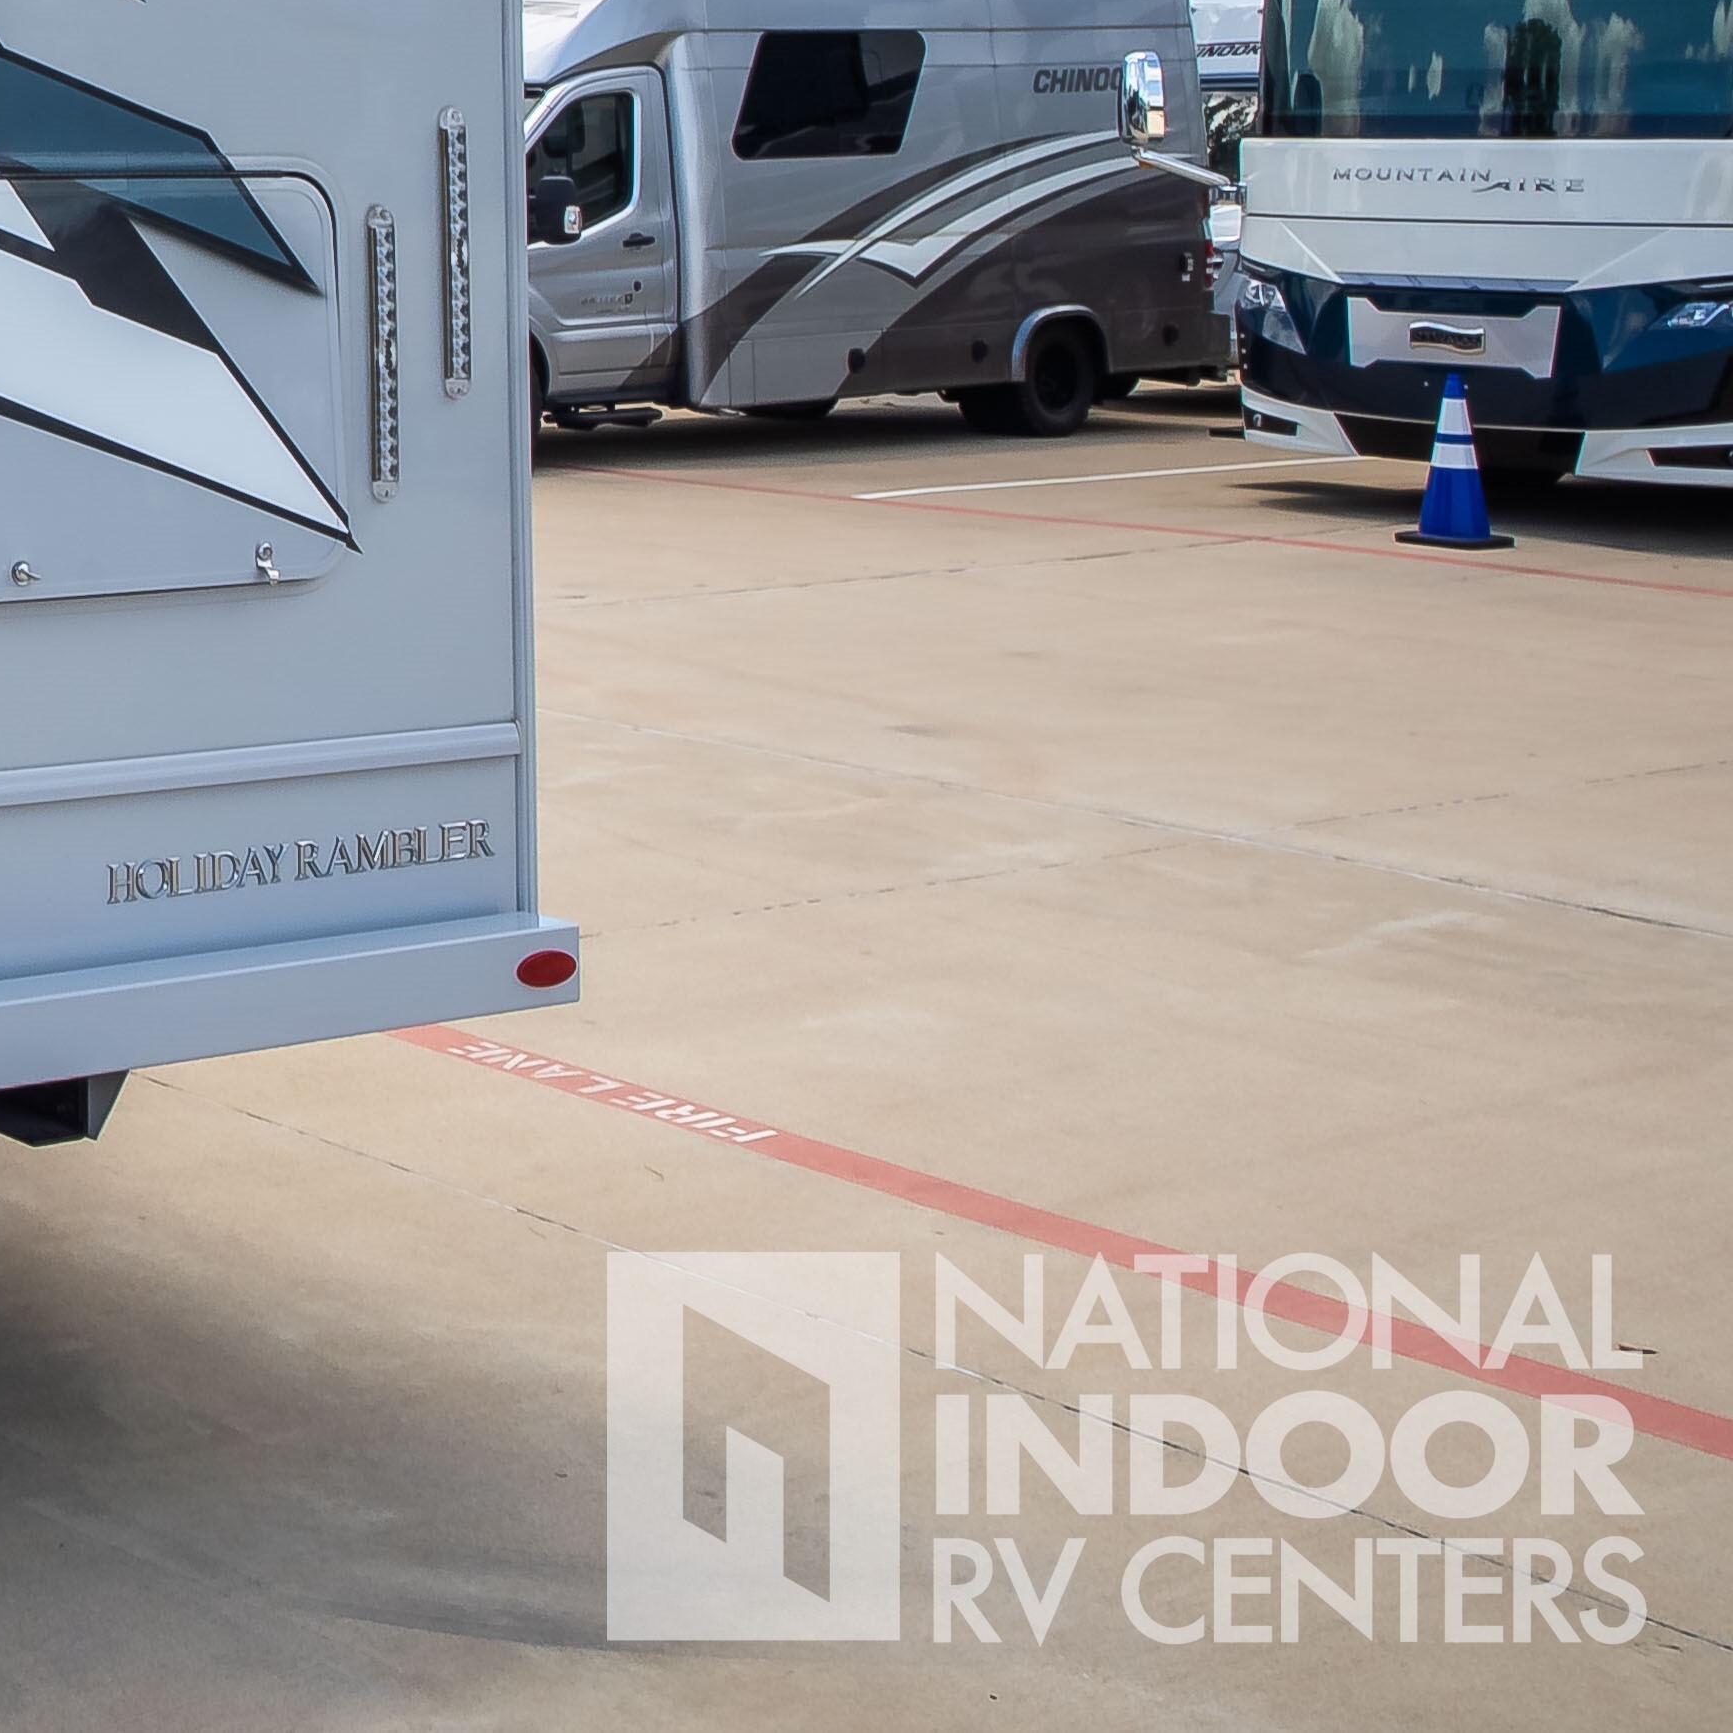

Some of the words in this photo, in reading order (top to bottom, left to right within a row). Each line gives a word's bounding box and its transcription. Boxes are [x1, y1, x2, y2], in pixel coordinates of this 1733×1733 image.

[1333, 167, 1492, 182] MOUNTAIN
[1471, 178, 1585, 193] AIRE
[105, 842, 290, 905] HOLIDAY
[293, 818, 496, 881] RAMBLER
[446, 1041, 625, 1094] LANE
[609, 1091, 779, 1143] FIRE
